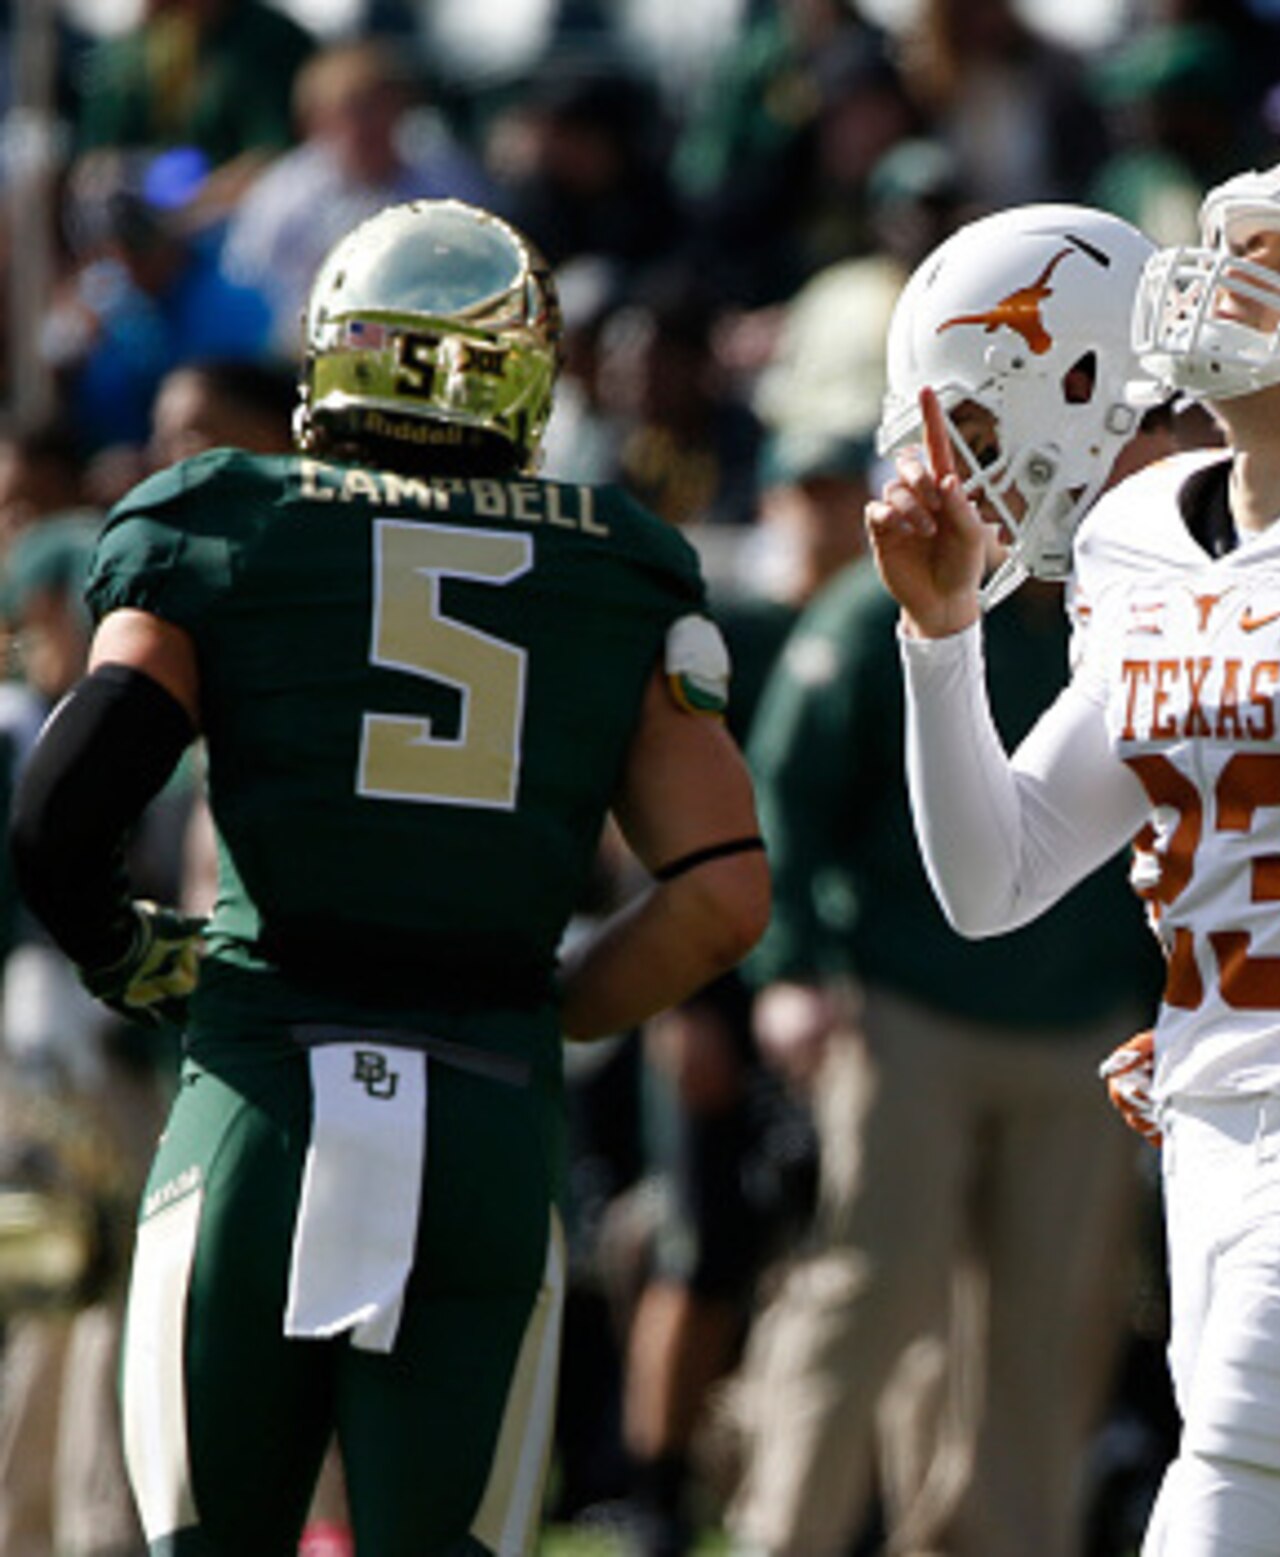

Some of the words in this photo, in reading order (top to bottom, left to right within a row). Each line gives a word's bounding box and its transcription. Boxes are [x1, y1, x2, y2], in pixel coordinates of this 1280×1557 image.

[396, 334, 440, 399] 5
[299, 460, 609, 537] CAMPBELL
[356, 517, 534, 811] 5
[353, 1051, 398, 1099] BU
